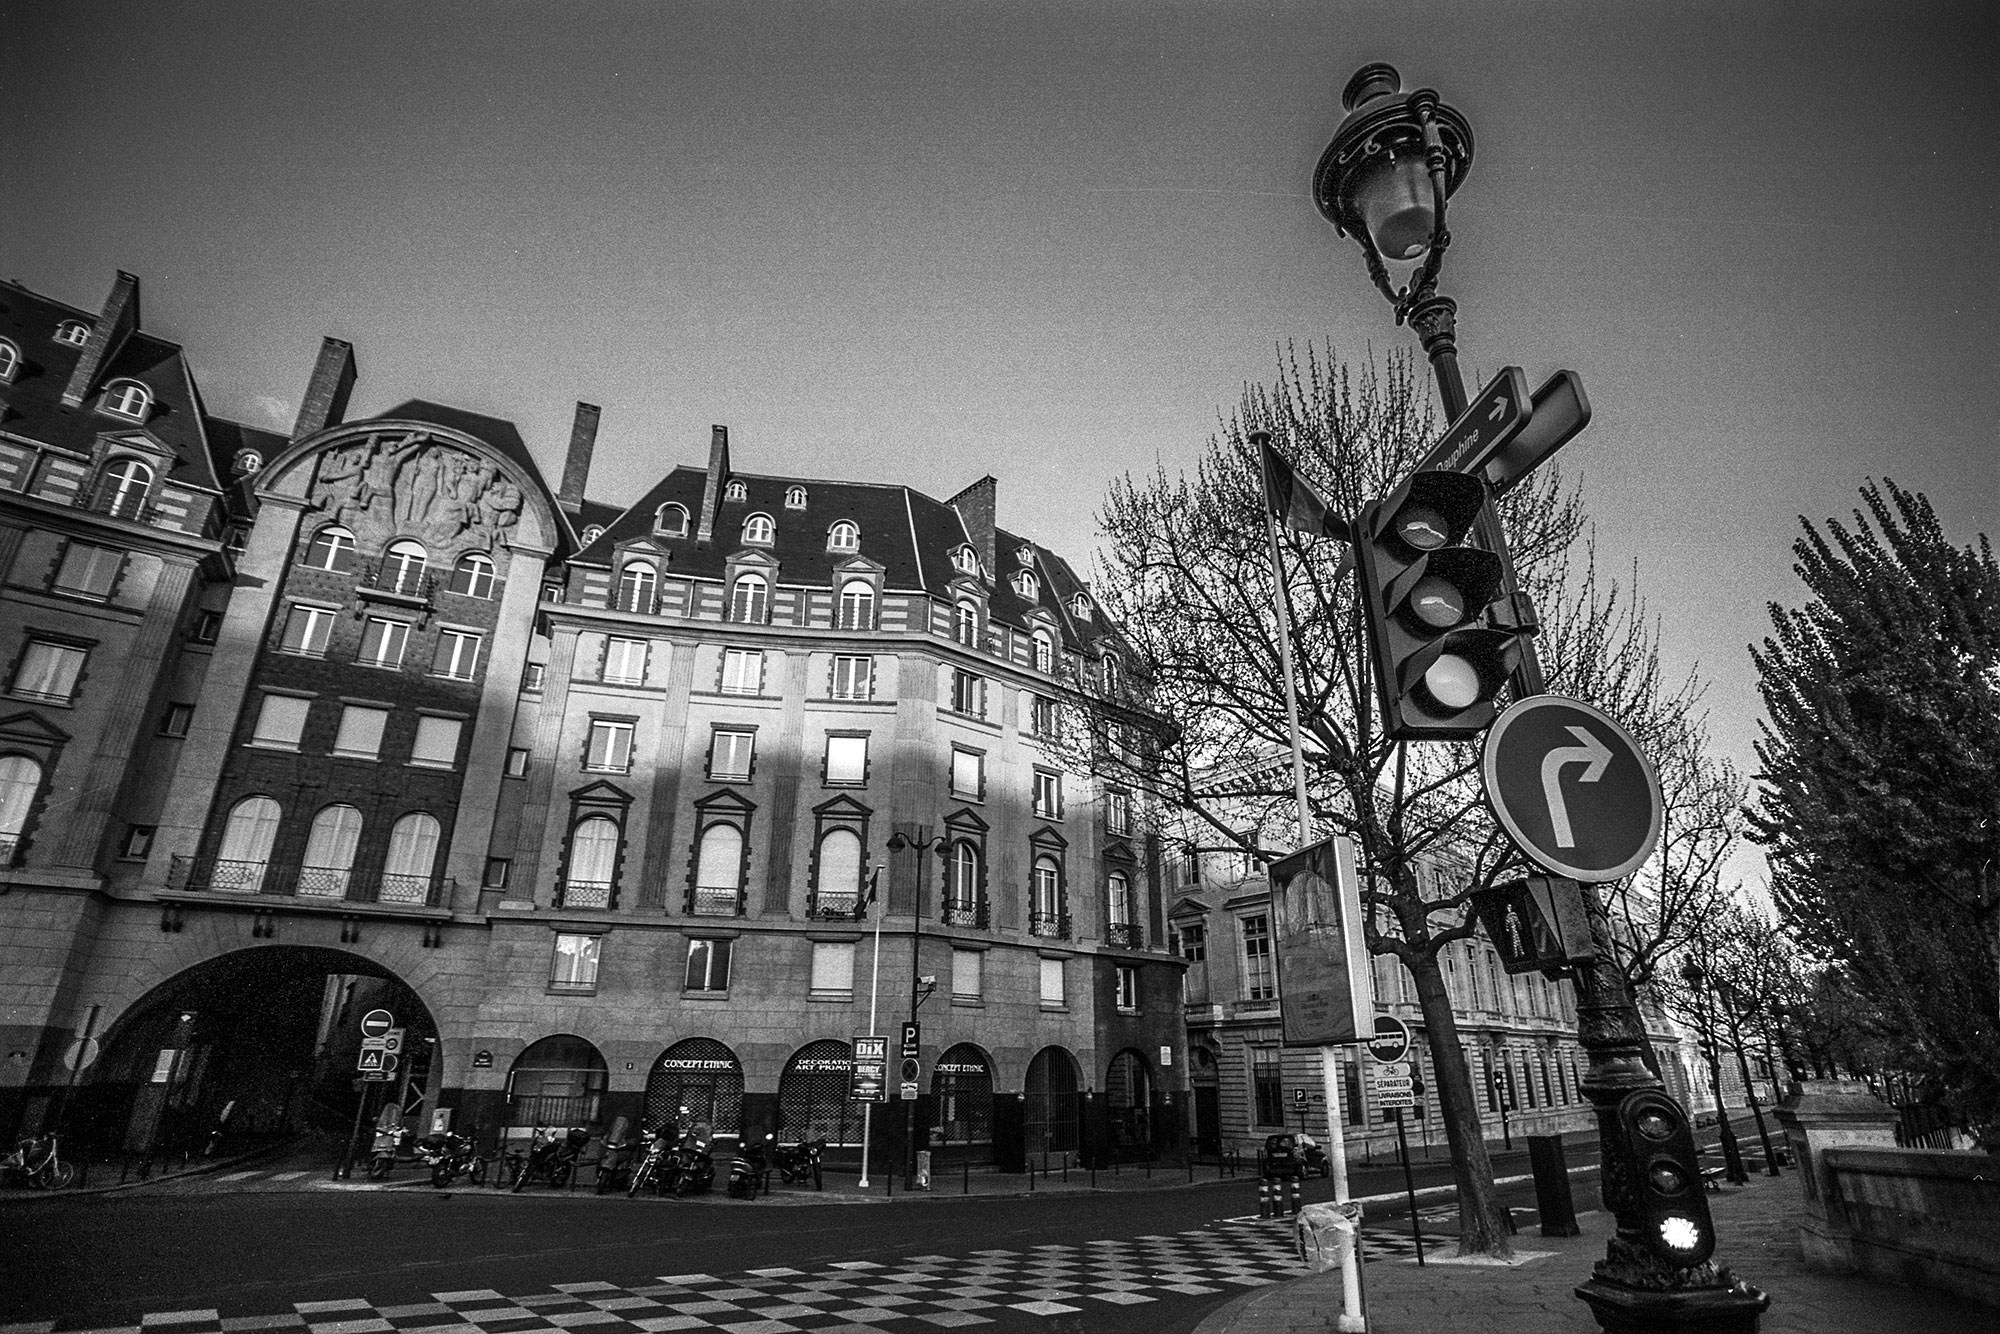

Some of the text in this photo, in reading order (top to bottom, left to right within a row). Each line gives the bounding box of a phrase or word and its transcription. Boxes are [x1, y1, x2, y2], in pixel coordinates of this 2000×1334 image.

[1436, 429, 1479, 471] Dauphine
[905, 1027, 916, 1043] P
[664, 1060, 733, 1069] CONCEPT ETHNIC
[934, 1064, 984, 1073] CONCEPT ETHNIC
[1297, 1090, 1303, 1100] P
[1378, 1091, 1412, 1099] LIVRAISONS
